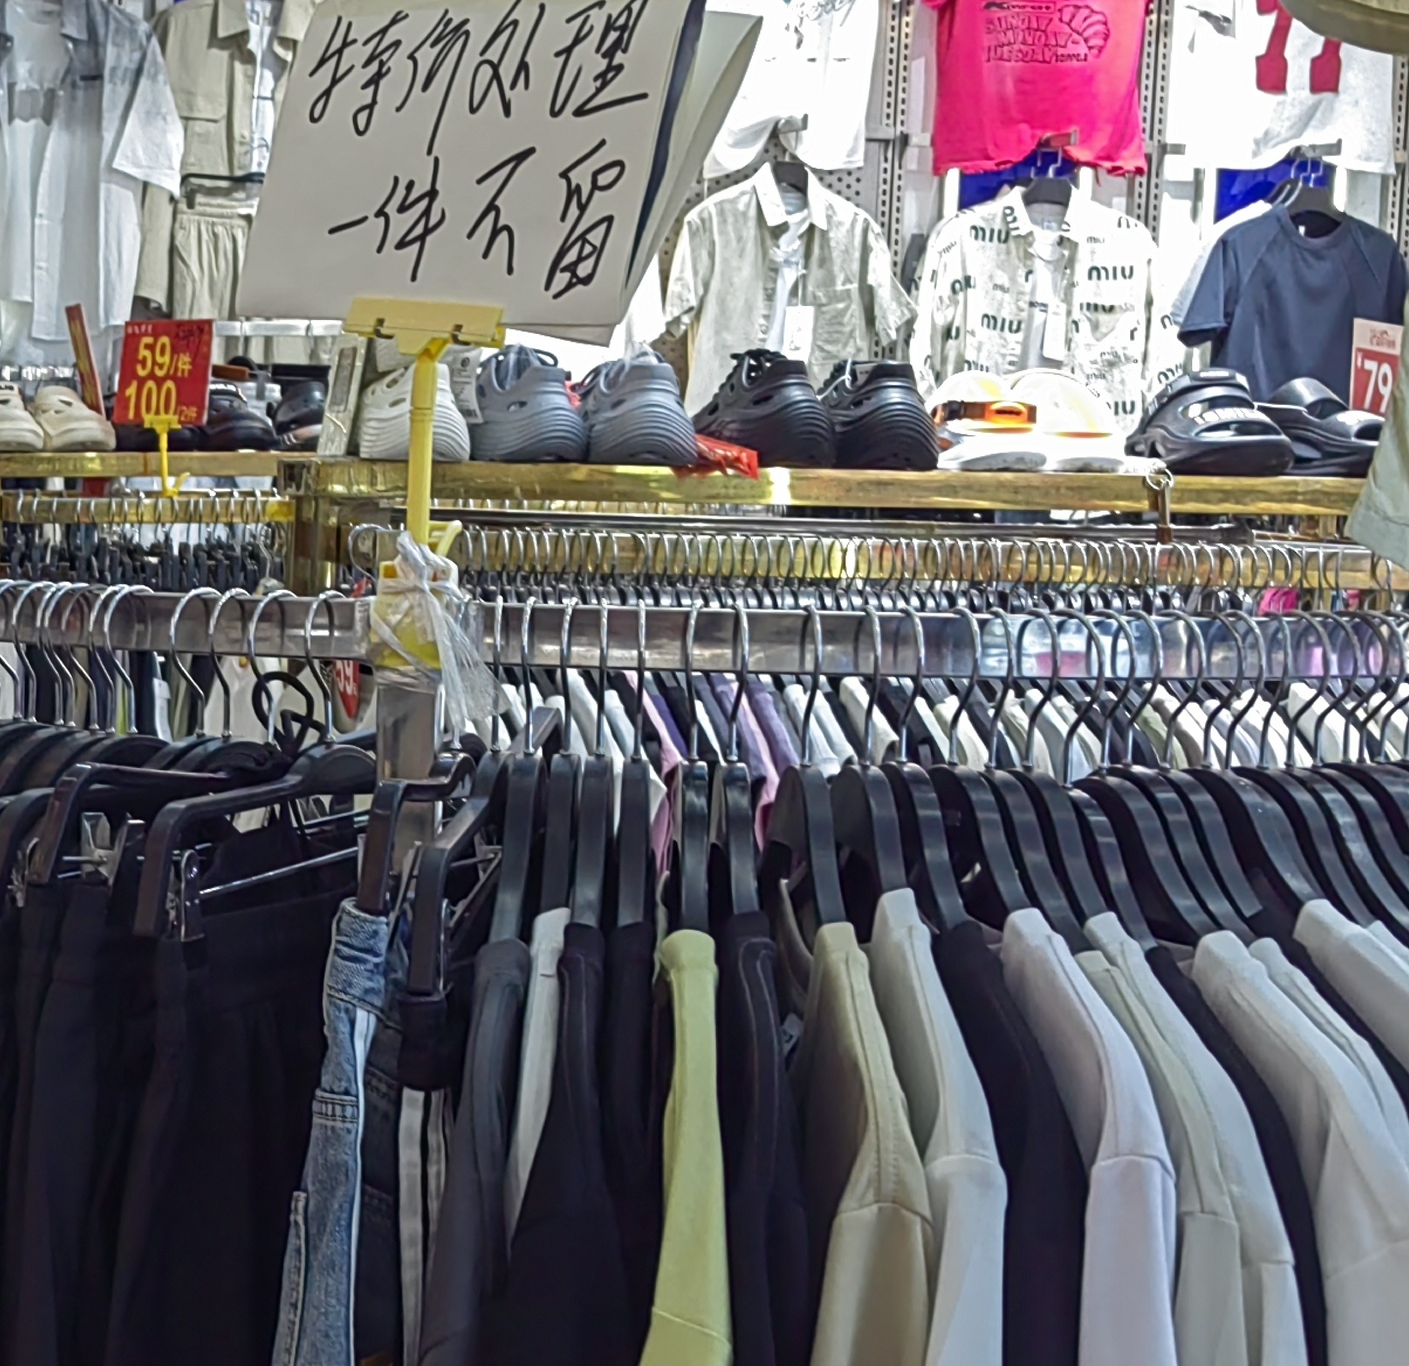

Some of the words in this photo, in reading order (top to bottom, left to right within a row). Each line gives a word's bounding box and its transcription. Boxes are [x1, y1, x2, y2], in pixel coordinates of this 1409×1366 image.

[327, 138, 627, 300] 一件不留
[135, 335, 193, 378] 59/件
